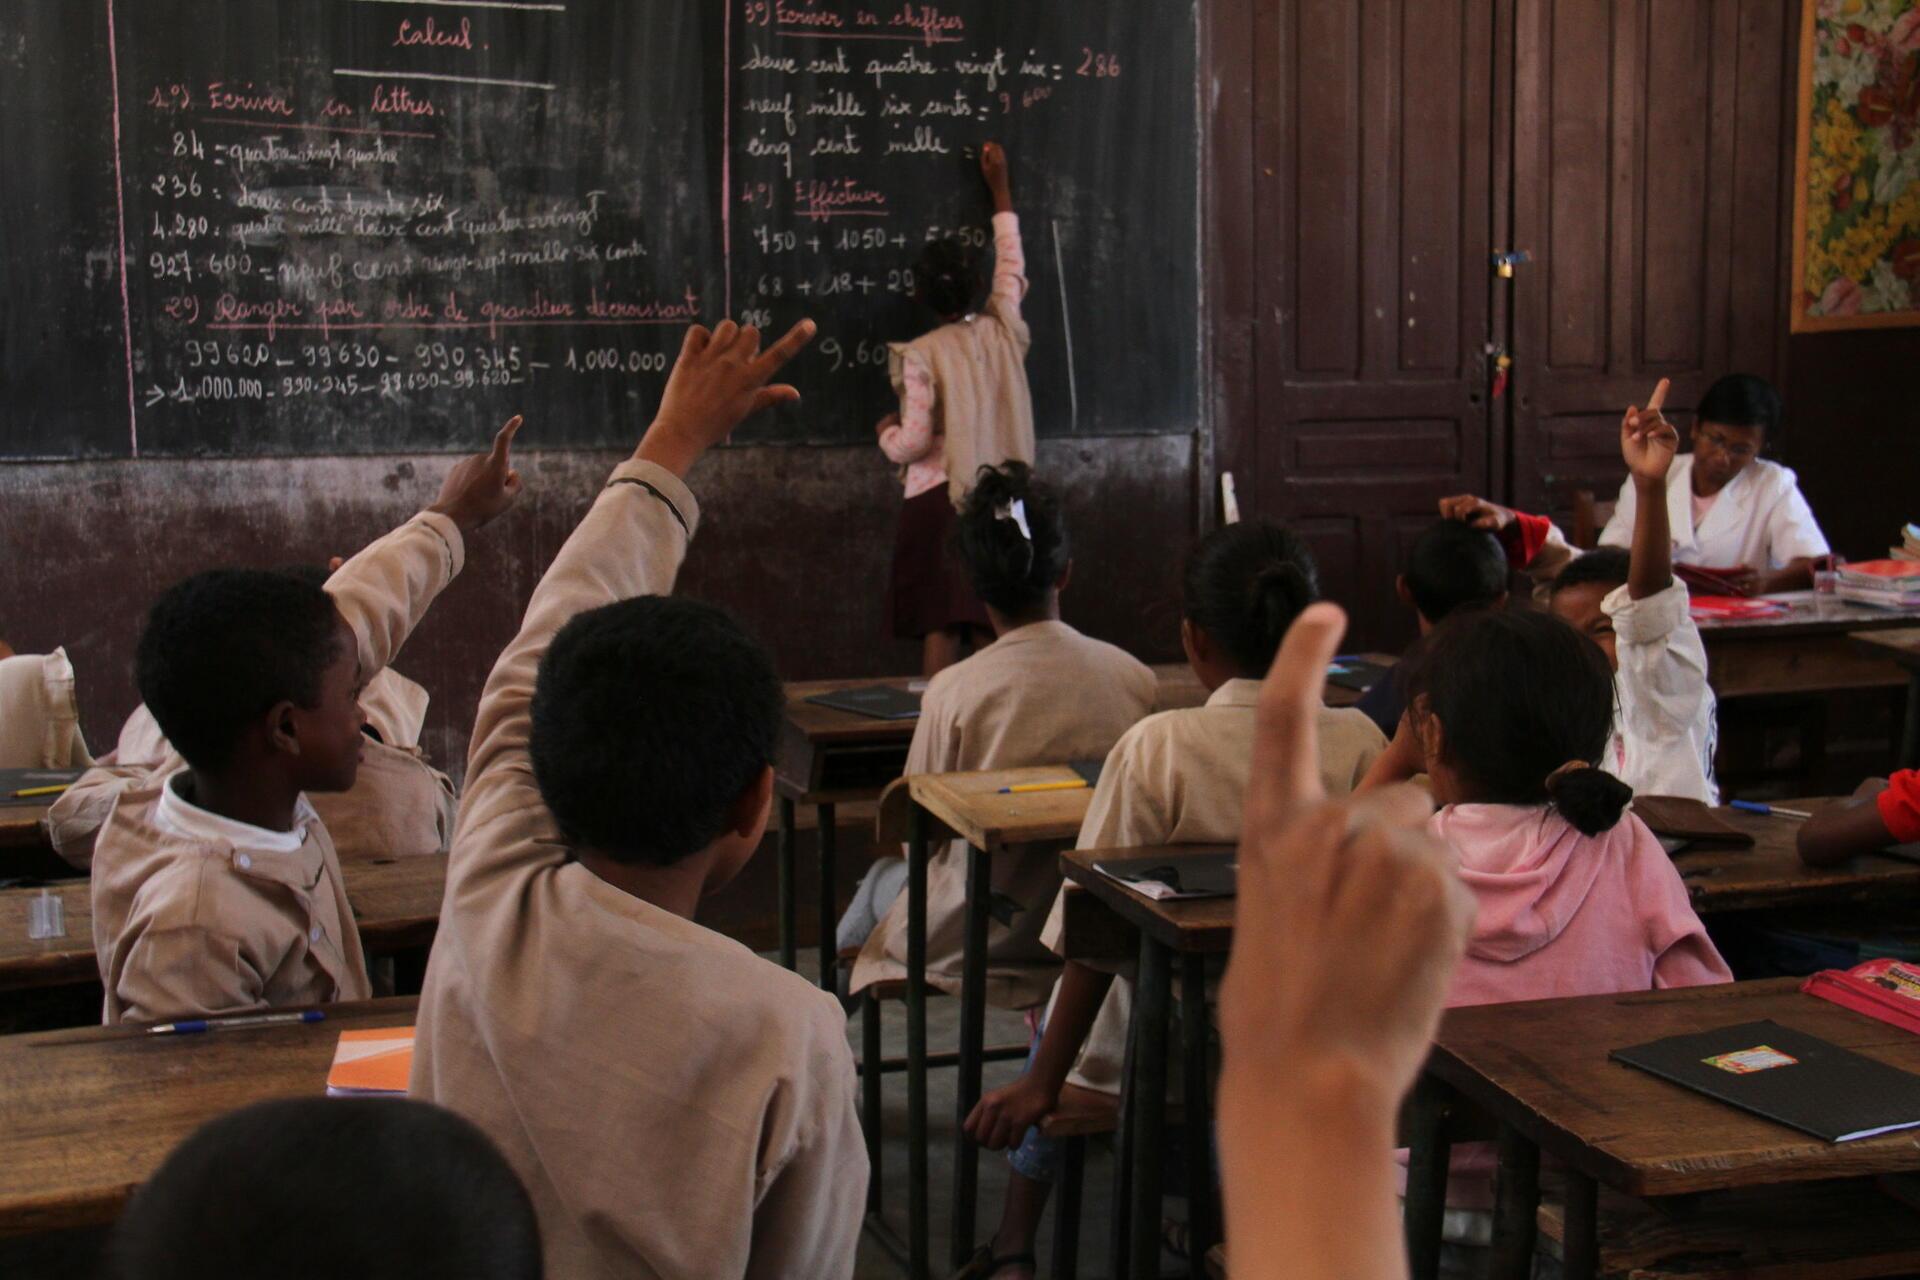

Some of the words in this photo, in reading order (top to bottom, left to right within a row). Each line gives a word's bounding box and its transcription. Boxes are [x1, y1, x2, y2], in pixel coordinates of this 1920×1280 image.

[856, 10, 879, 25] en
[888, 3, 964, 48] chiffres
[741, 43, 798, 73] deux
[805, 46, 850, 73] cent
[1020, 48, 1047, 77] six
[1076, 47, 1121, 78] 286
[320, 97, 353, 116] en
[744, 92, 797, 136] neuf
[806, 88, 866, 117] mille
[880, 94, 912, 117] six
[920, 89, 972, 117] cents
[172, 129, 205, 160] 84
[346, 136, 399, 170] quatre
[747, 127, 792, 178] cinq
[810, 124, 861, 156] cent
[883, 122, 950, 156] mille
[151, 172, 203, 199] 236
[236, 183, 282, 212] deux
[291, 184, 334, 216] cent
[411, 192, 446, 219] six
[152, 211, 209, 240] 4.280
[353, 215, 409, 237] deux
[416, 208, 461, 237] cent
[753, 224, 797, 254] 750
[834, 226, 887, 252] 1050
[278, 252, 343, 289] neuf
[353, 254, 416, 281] cent
[511, 242, 570, 266] mille
[758, 273, 783, 297] 68
[213, 292, 302, 343] Ranger
[315, 298, 364, 341] par
[444, 290, 469, 322] de
[480, 289, 576, 341] grandeur
